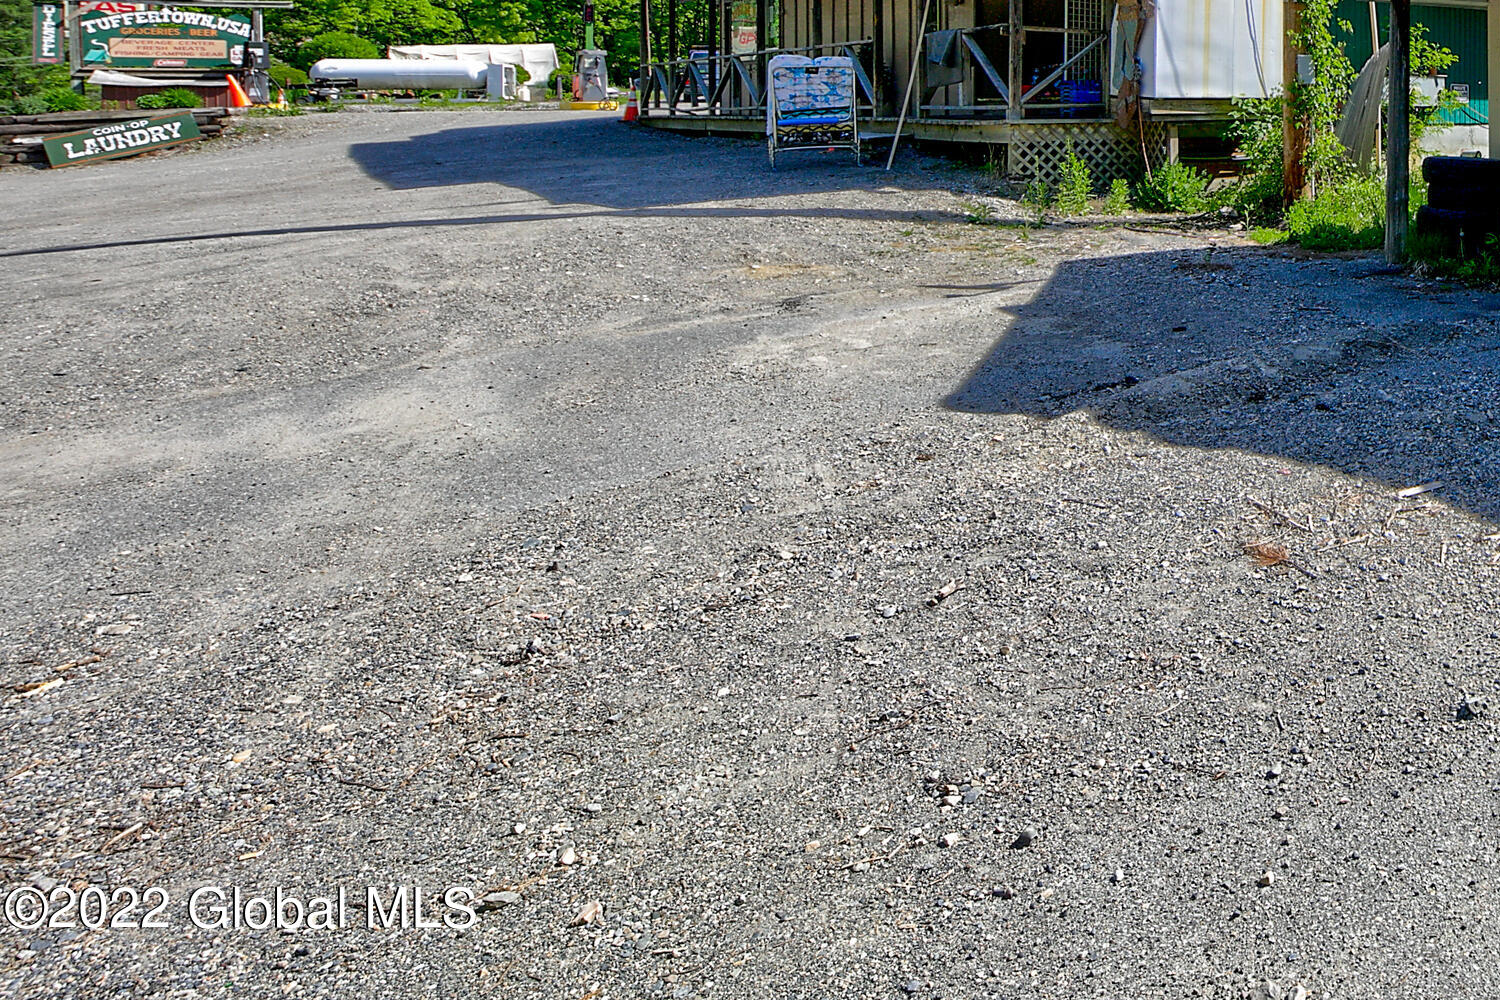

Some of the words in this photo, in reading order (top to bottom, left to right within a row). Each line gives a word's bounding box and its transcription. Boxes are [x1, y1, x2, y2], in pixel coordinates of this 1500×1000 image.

[119, 27, 181, 36] GROCERIES
[189, 28, 218, 37] BEER
[63, 121, 181, 159] LAUNDRY
